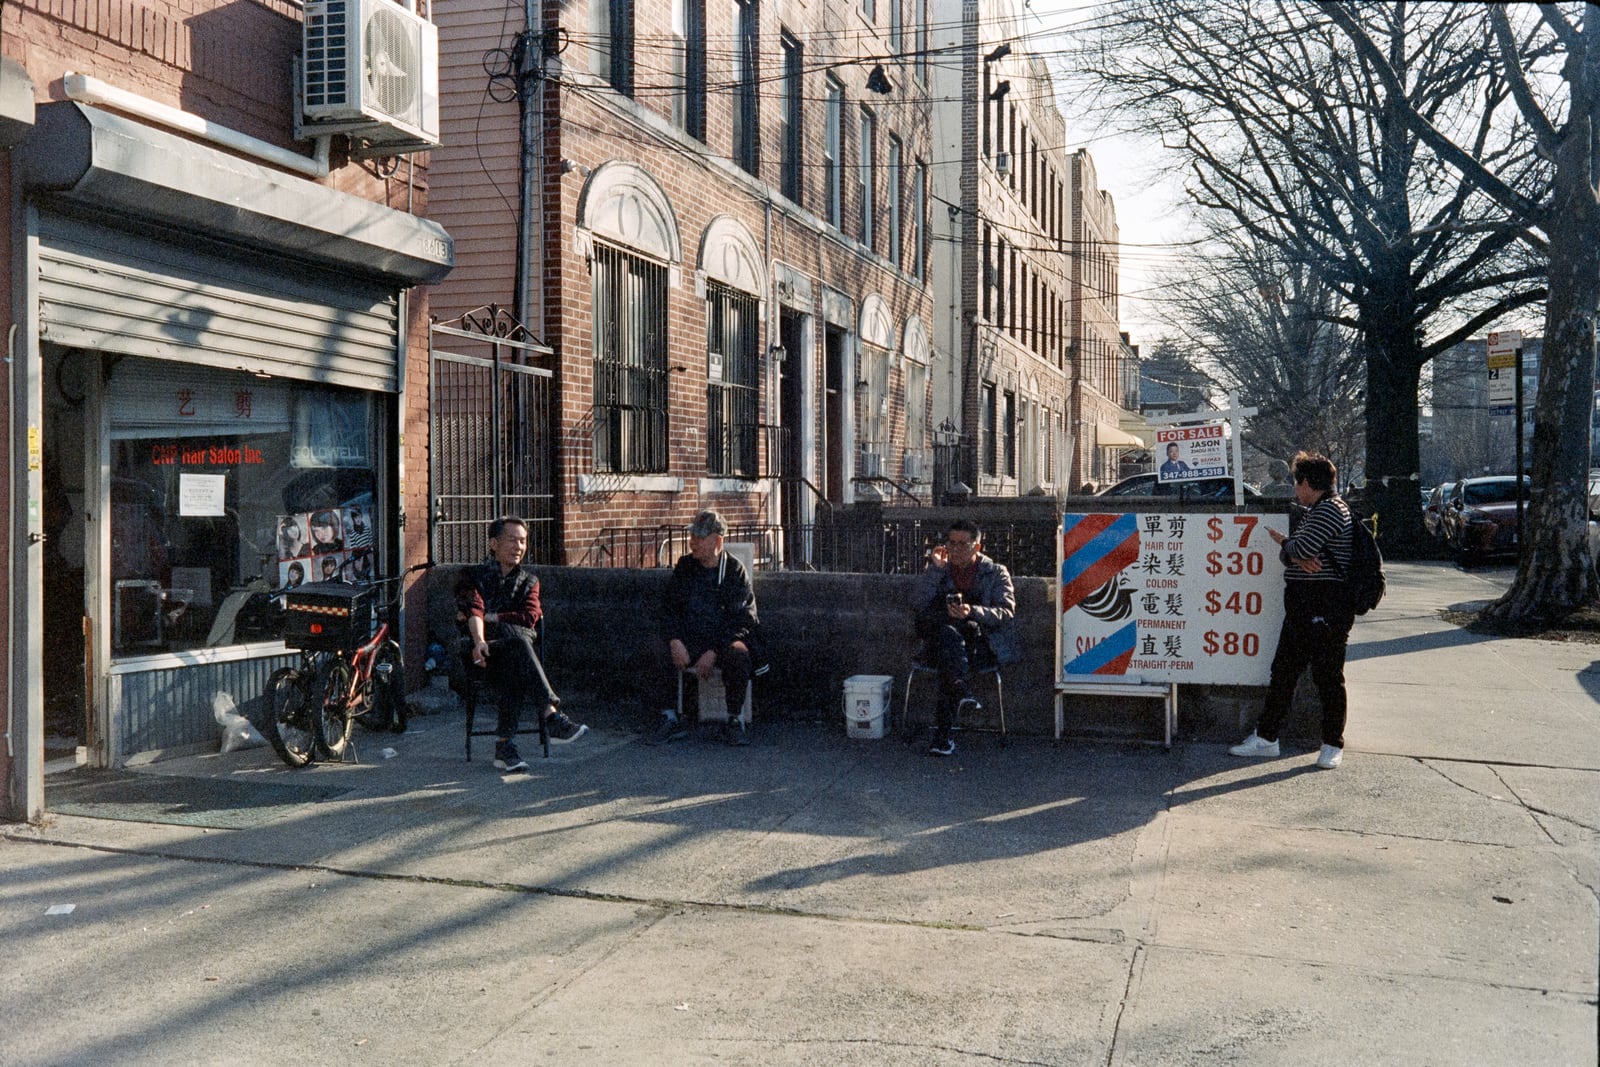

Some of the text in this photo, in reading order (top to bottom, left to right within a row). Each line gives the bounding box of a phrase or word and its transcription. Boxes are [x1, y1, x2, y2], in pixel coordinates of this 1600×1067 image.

[1160, 428, 1220, 441] FOR SALE
[1190, 440, 1220, 448] JASON
[181, 447, 206, 465] Hair
[209, 445, 241, 465] Salon
[244, 444, 265, 465] Inc.
[1163, 468, 1223, 479] 347-988-5318
[1143, 515, 1187, 539] 單剪
[1145, 541, 1184, 551] HAIR CUT
[1142, 552, 1186, 576] 染髮
[1206, 550, 1264, 577] $30
[1146, 579, 1178, 589] COLORS
[1140, 593, 1184, 616] 電髮
[1205, 589, 1262, 616] $40
[1137, 619, 1186, 630] PERMANENT
[1139, 634, 1183, 658] 直髮
[1203, 629, 1259, 656] $80
